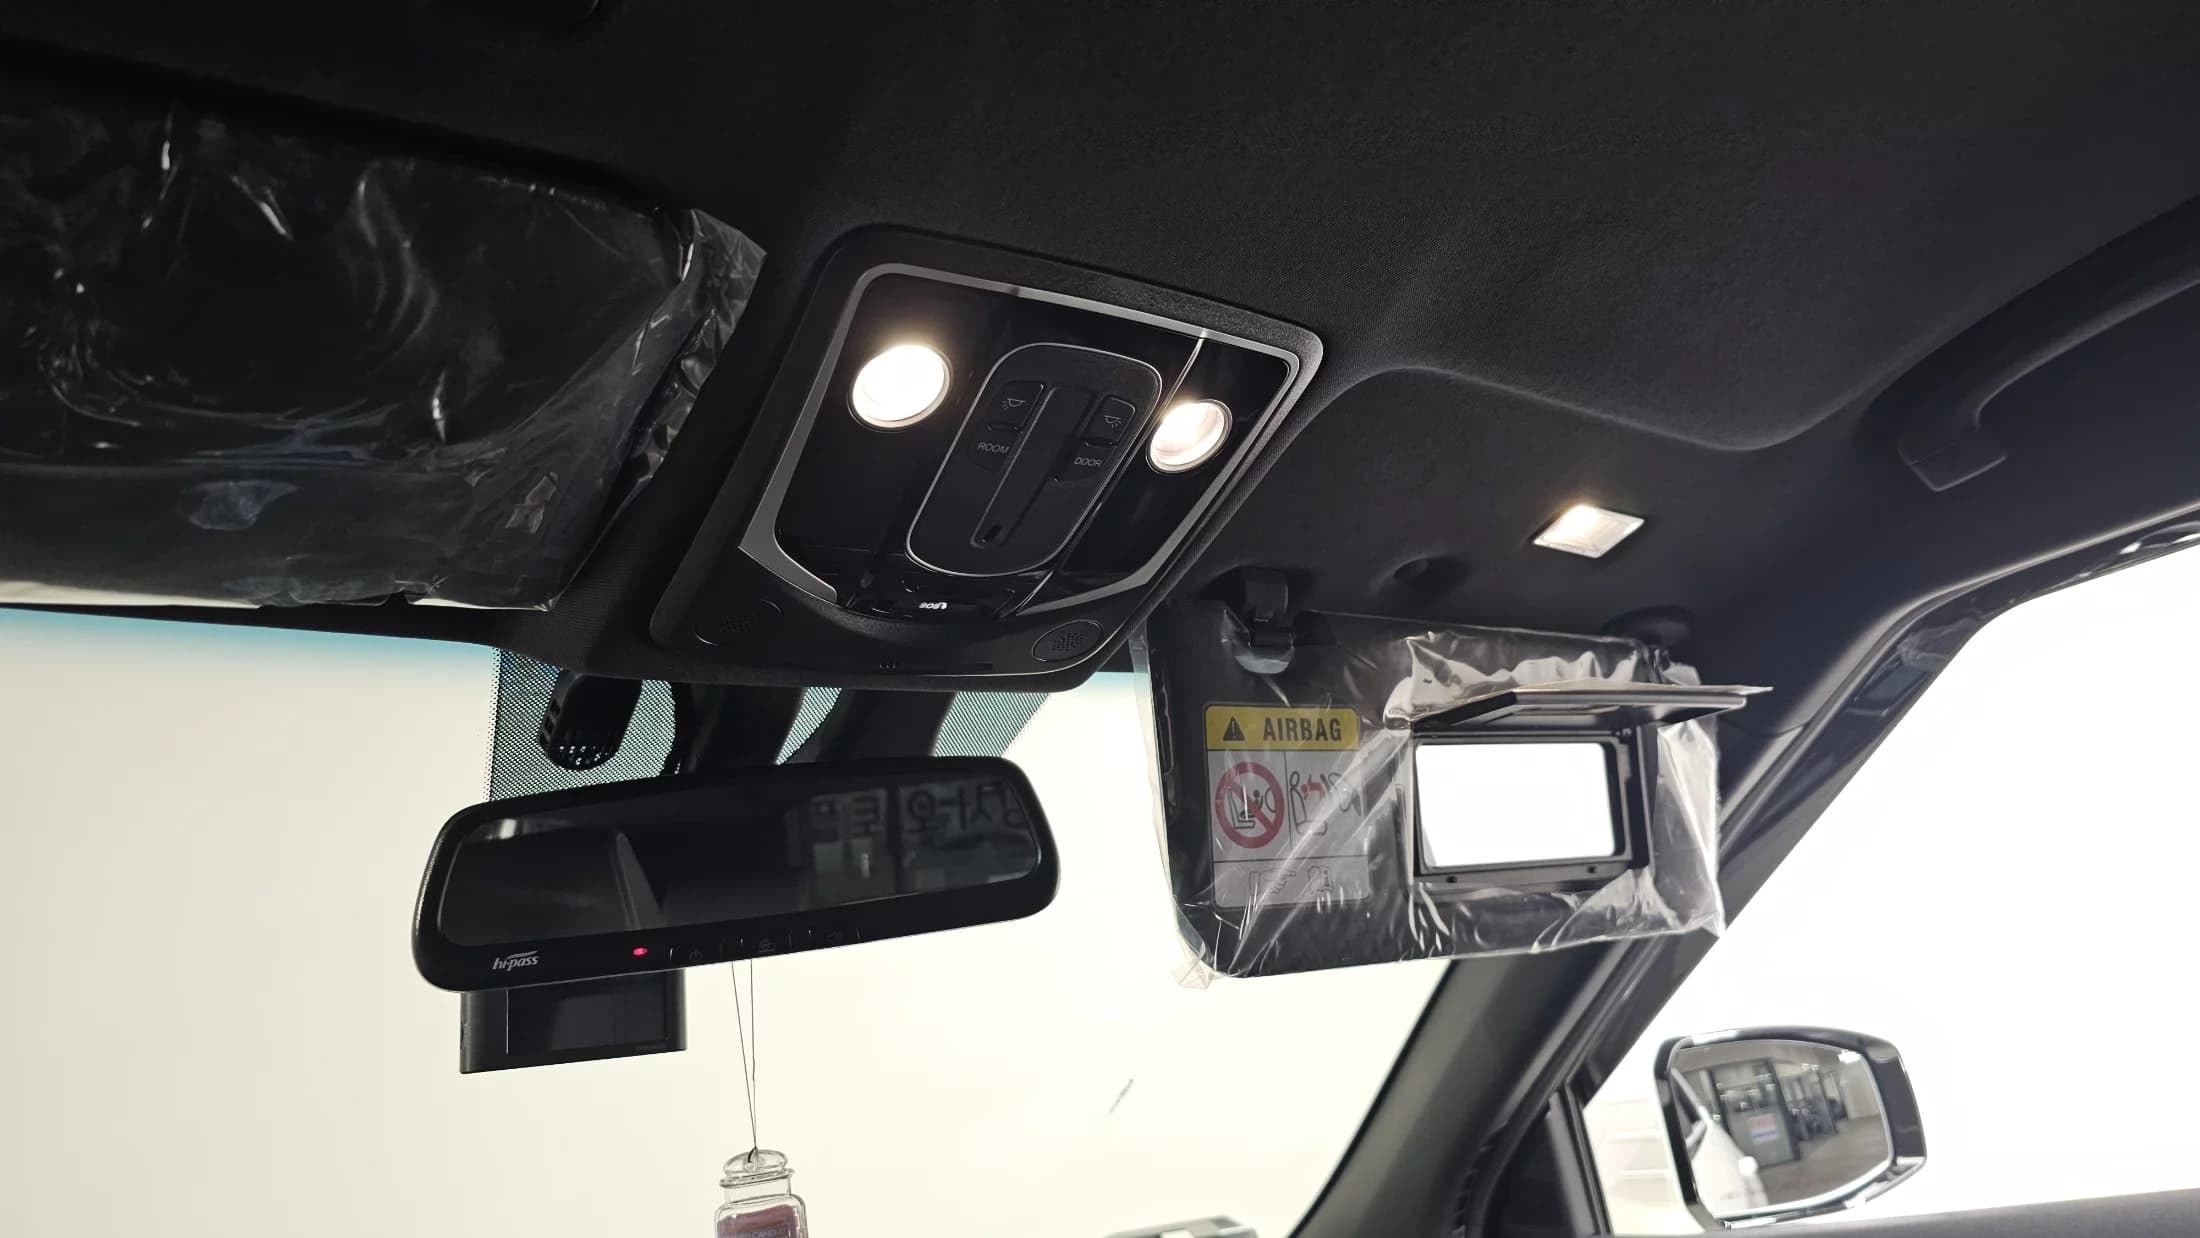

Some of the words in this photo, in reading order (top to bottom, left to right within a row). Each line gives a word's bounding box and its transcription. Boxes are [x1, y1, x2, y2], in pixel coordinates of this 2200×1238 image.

[977, 442, 1010, 454] ROOM
[1074, 456, 1103, 468] DOOR
[1264, 717, 1342, 742] AIRBAG
